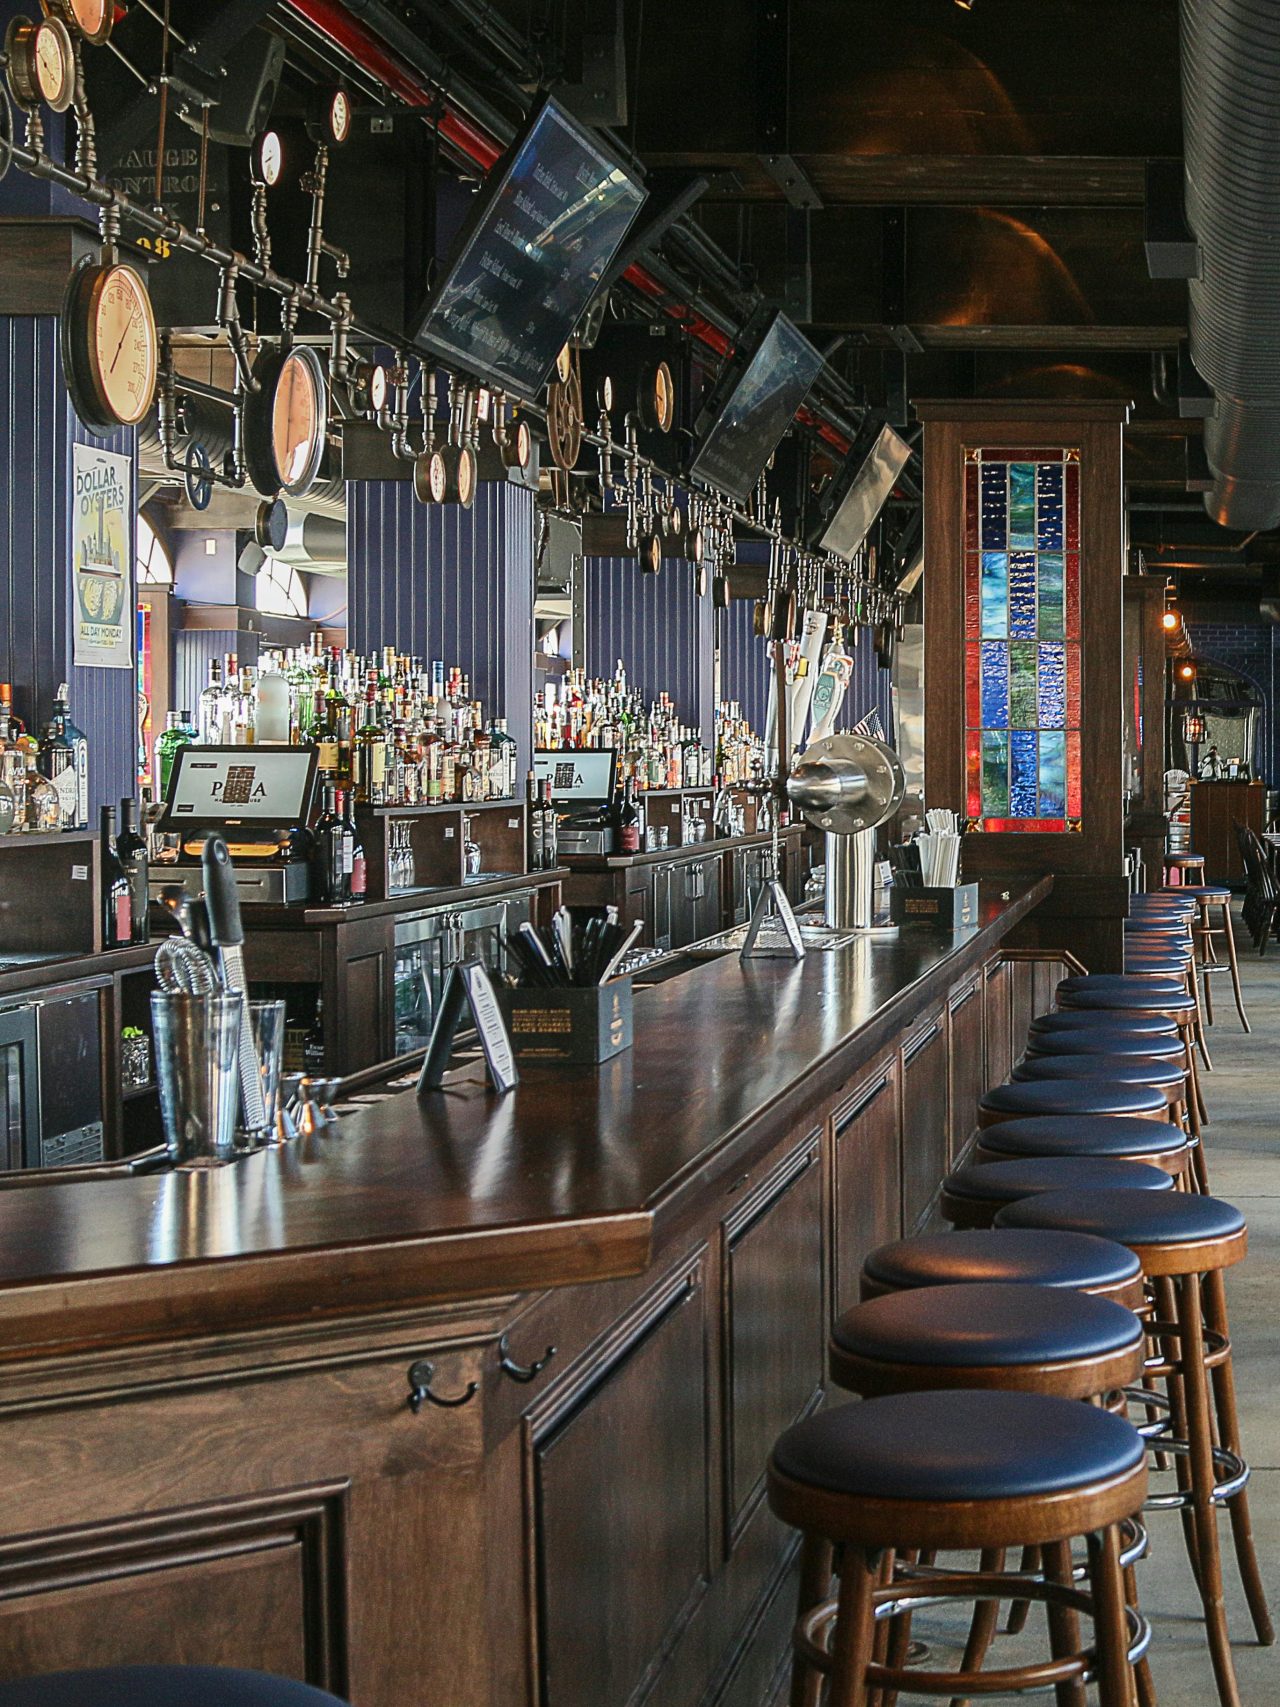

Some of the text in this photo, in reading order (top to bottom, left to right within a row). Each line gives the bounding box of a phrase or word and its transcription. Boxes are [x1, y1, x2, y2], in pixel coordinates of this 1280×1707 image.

[113, 149, 199, 168] AUGE
[77, 466, 117, 496] DOLLAR
[81, 485, 125, 516] OYSTERS
[80, 625, 122, 639] ALL DAY MONDAY
